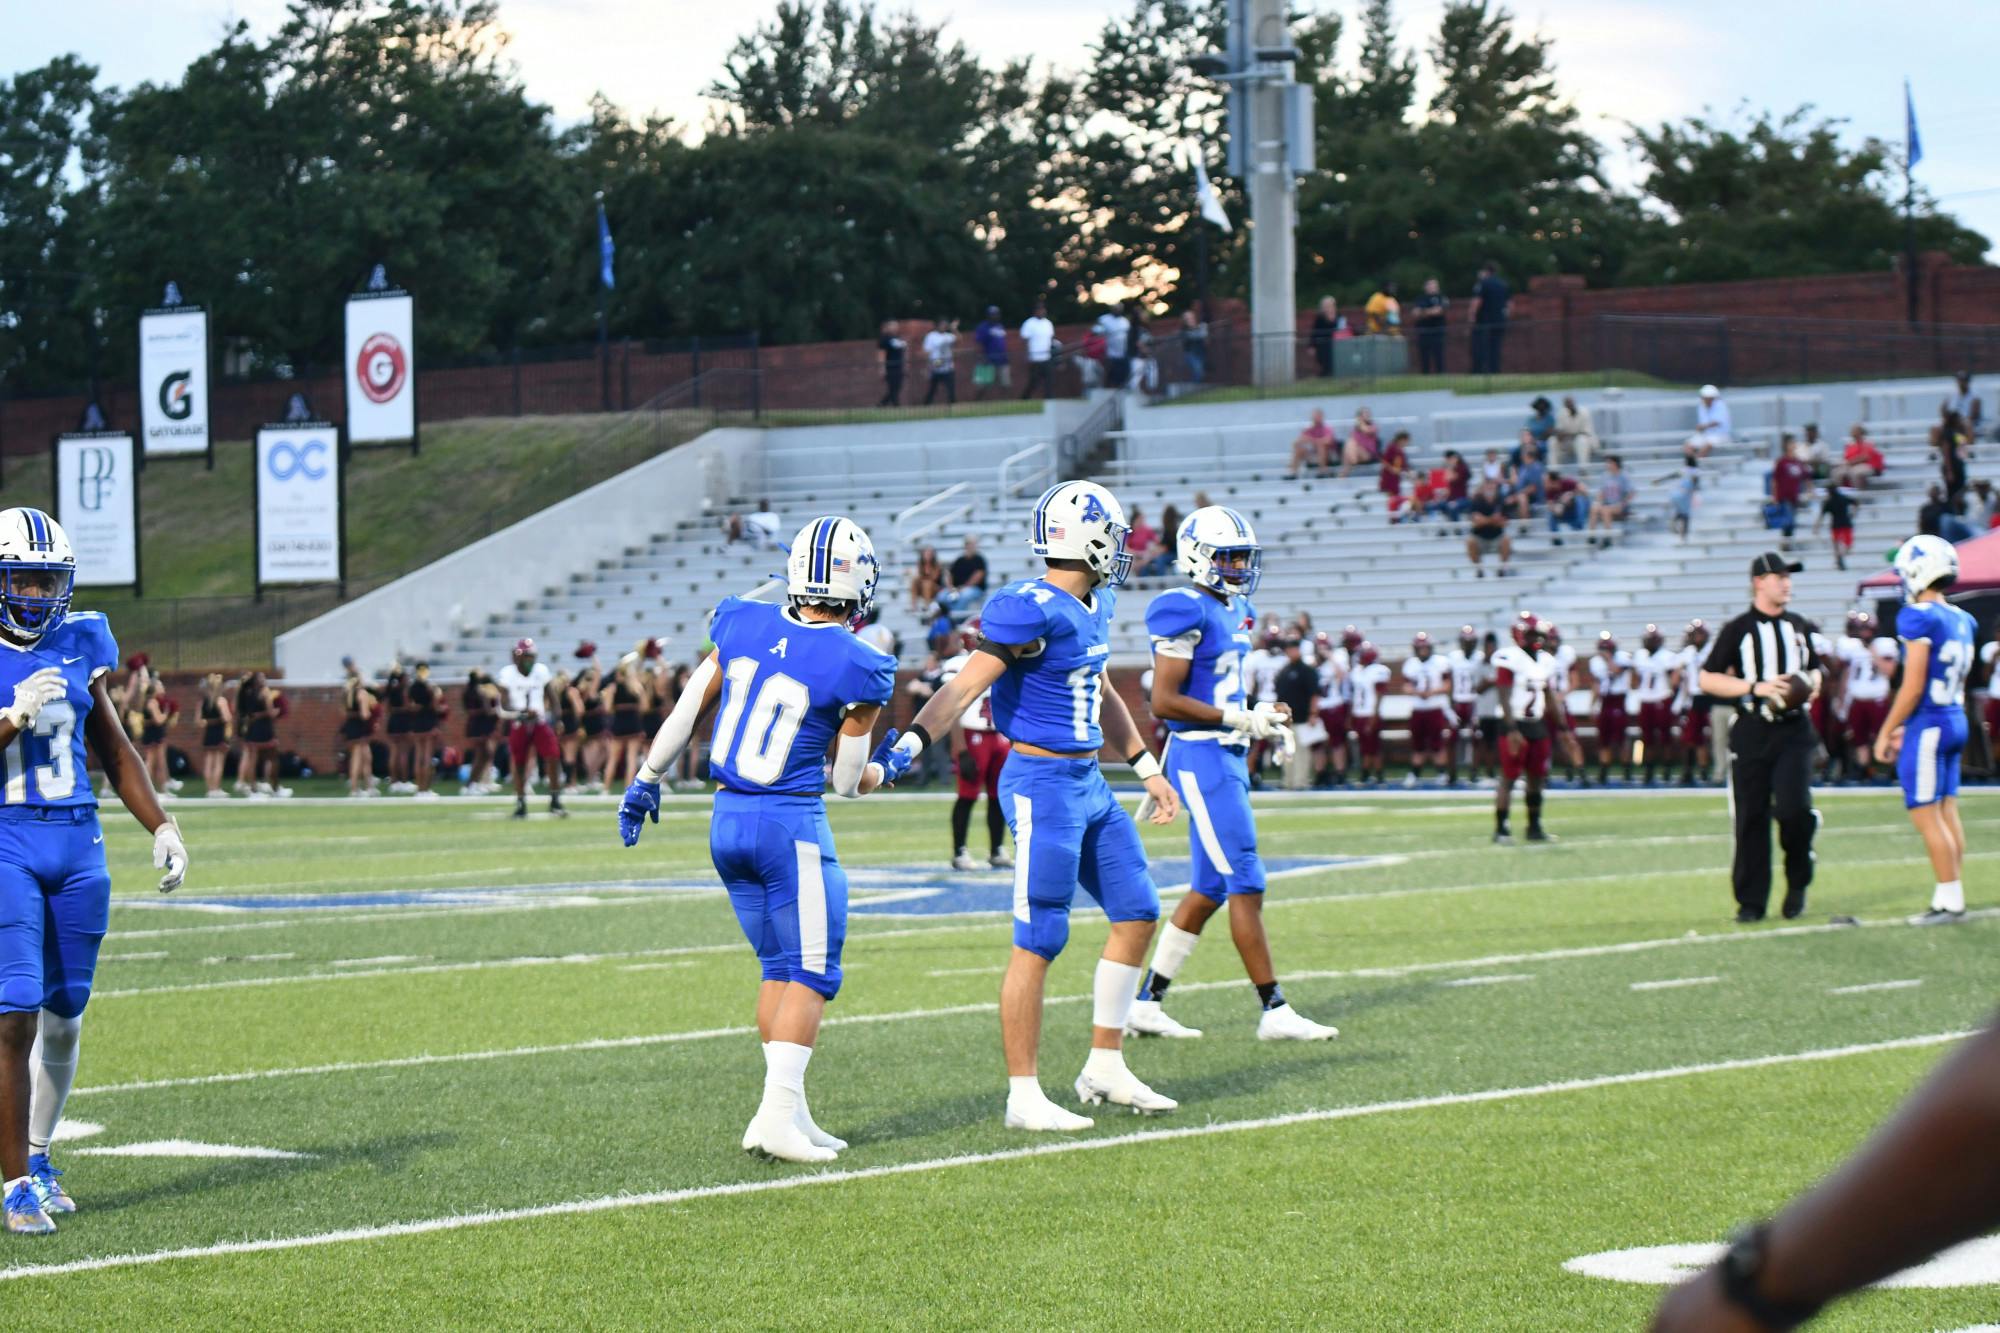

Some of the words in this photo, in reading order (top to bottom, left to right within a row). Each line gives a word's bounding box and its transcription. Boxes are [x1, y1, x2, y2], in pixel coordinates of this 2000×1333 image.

[159, 369, 192, 421] G
[268, 440, 328, 481] OC
[1081, 493, 1111, 523] A
[768, 637, 788, 658] A
[710, 656, 810, 786] 10
[4, 699, 76, 804] 13
